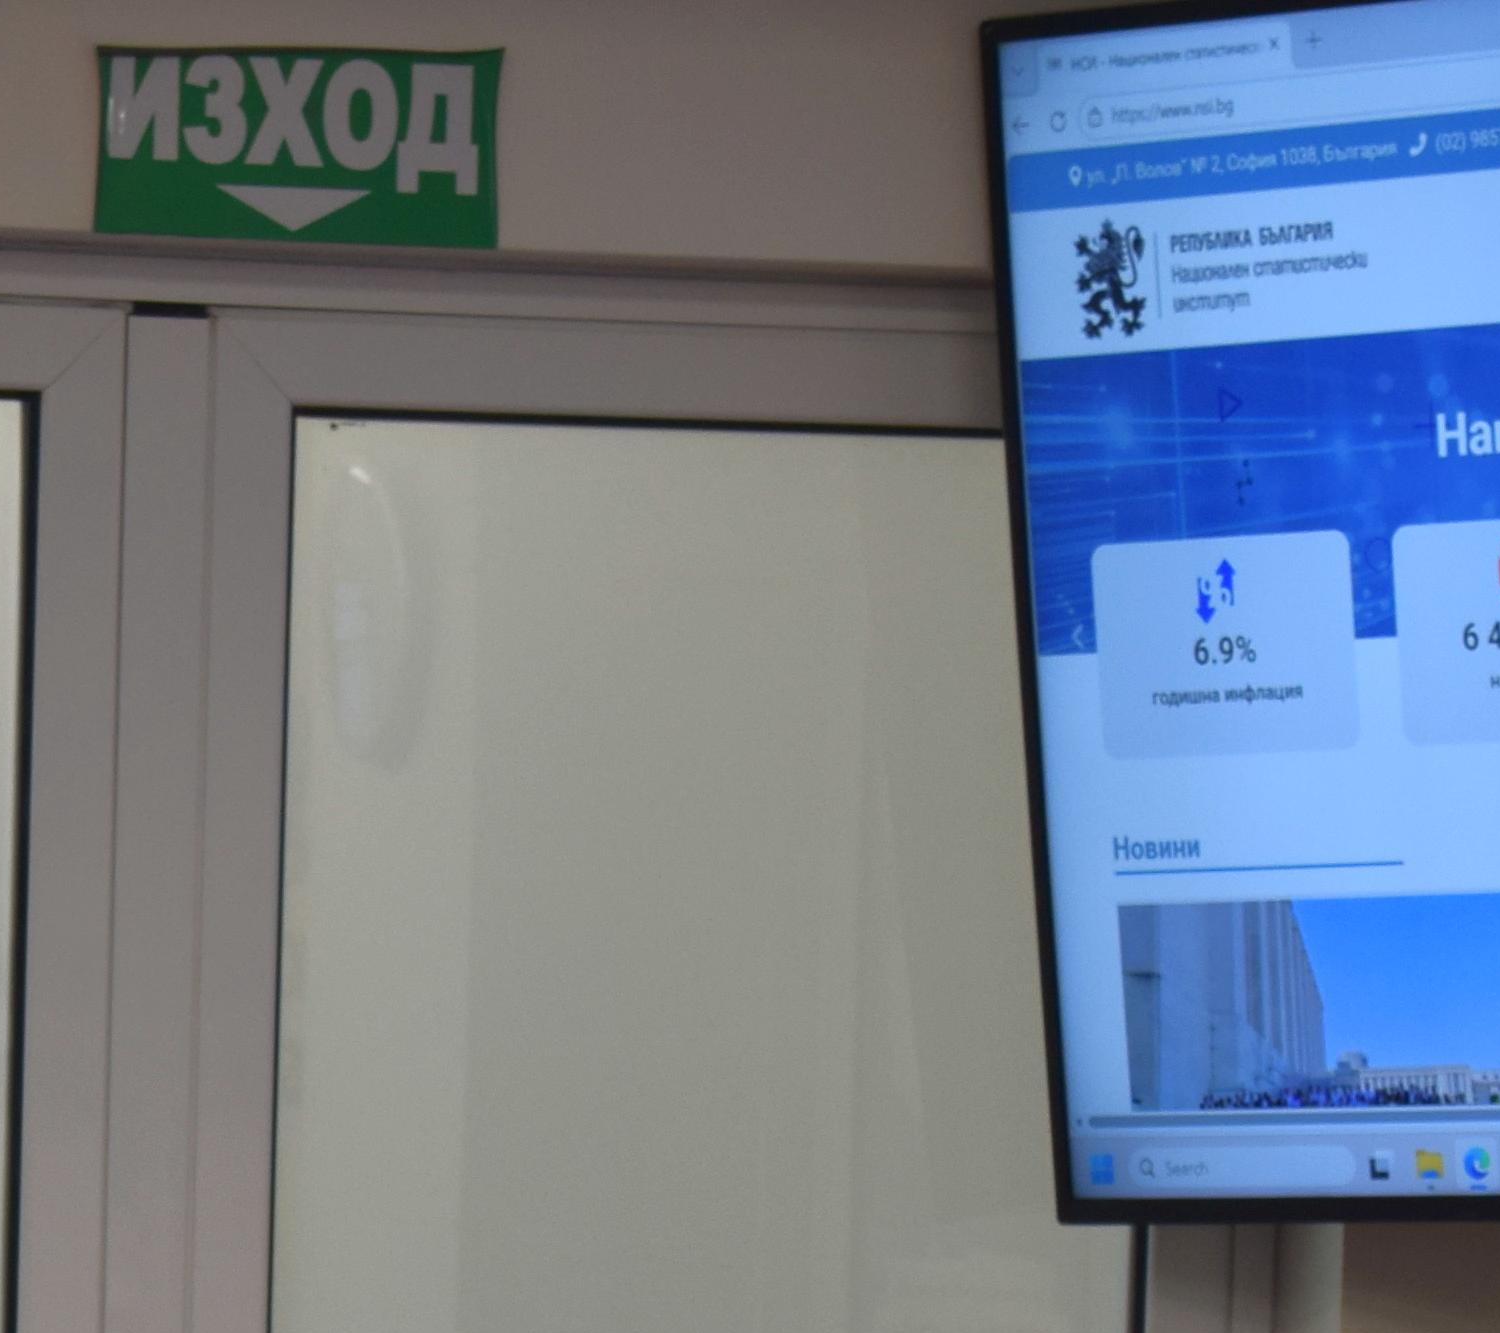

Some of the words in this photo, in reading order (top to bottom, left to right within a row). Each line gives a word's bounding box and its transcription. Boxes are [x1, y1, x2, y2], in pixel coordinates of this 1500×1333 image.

[106, 54, 479, 195] ИЗХОД
[1227, 150, 1278, 173] София
[1323, 141, 1398, 164] България
[1436, 132, 1465, 153] (02)
[1170, 229, 1252, 253] РЕПУБЛИКА
[1259, 221, 1333, 247] БЪЛГАРИЯ
[1193, 635, 1257, 665] 6.9%
[1463, 622, 1479, 651] 6
[1152, 685, 1221, 707] годишна
[1225, 682, 1303, 705] инфлация
[1112, 834, 1201, 863] Новини
